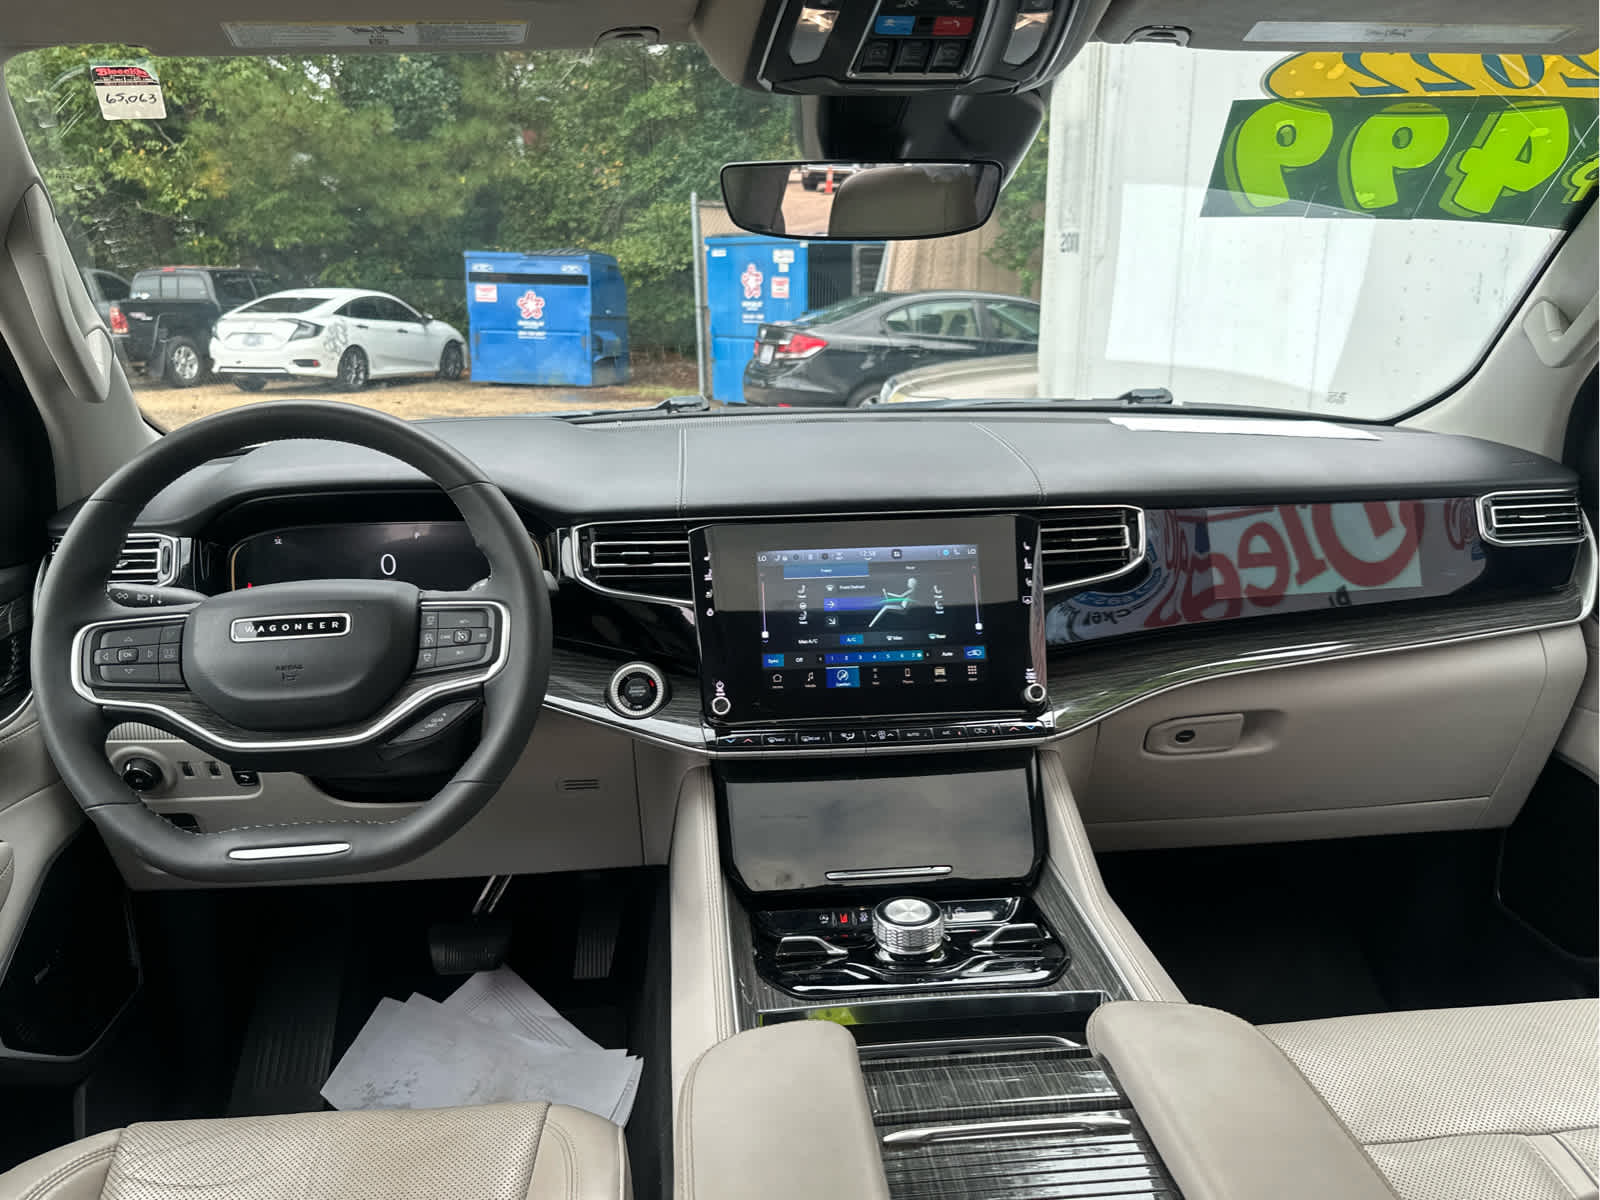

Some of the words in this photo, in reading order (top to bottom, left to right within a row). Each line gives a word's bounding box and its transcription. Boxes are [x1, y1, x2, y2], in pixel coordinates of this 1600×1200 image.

[106, 93, 157, 104] 65,063
[380, 553, 397, 576] 0
[244, 621, 340, 634] WAGONEER
